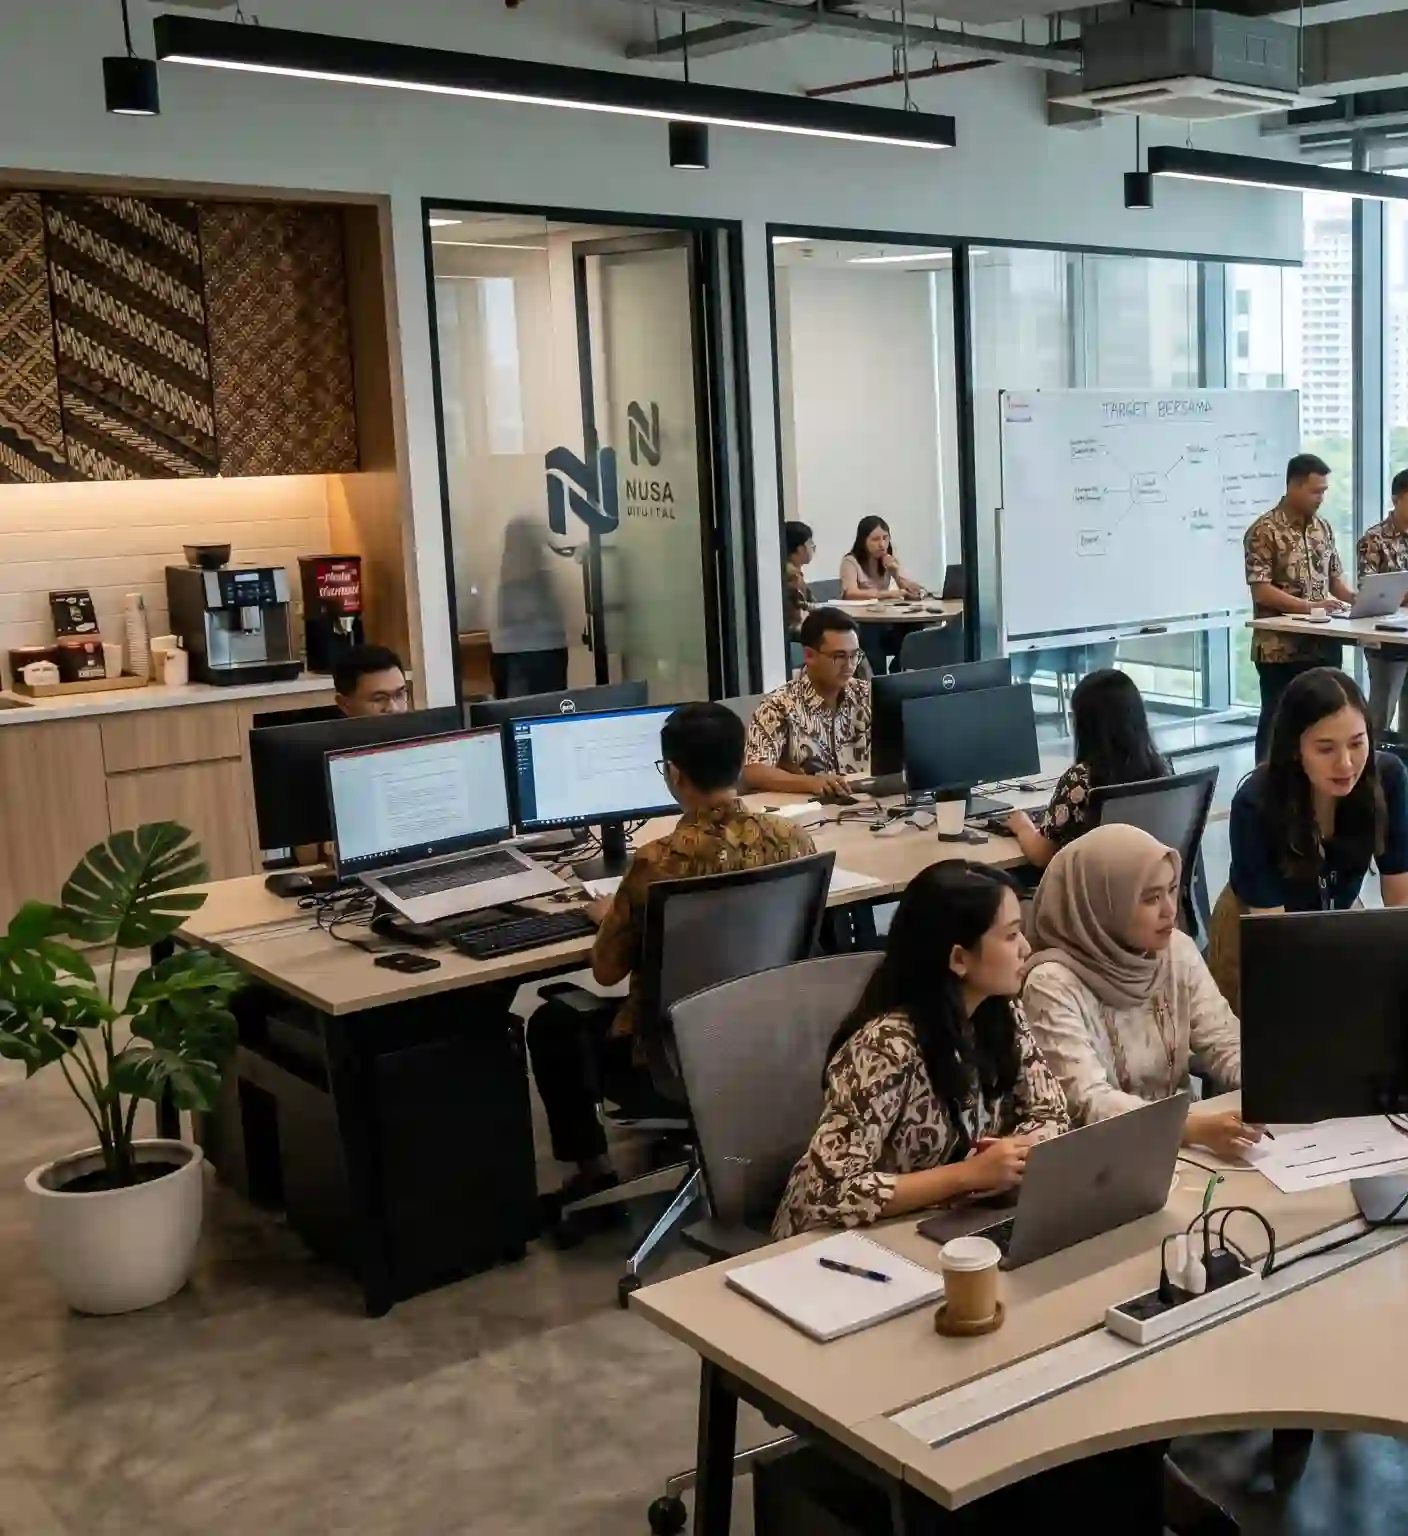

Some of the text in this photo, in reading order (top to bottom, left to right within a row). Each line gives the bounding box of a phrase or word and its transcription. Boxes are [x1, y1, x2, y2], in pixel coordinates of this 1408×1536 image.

[1101, 399, 1213, 418] TARGET BERSAMA
[626, 479, 674, 503] NUSA
